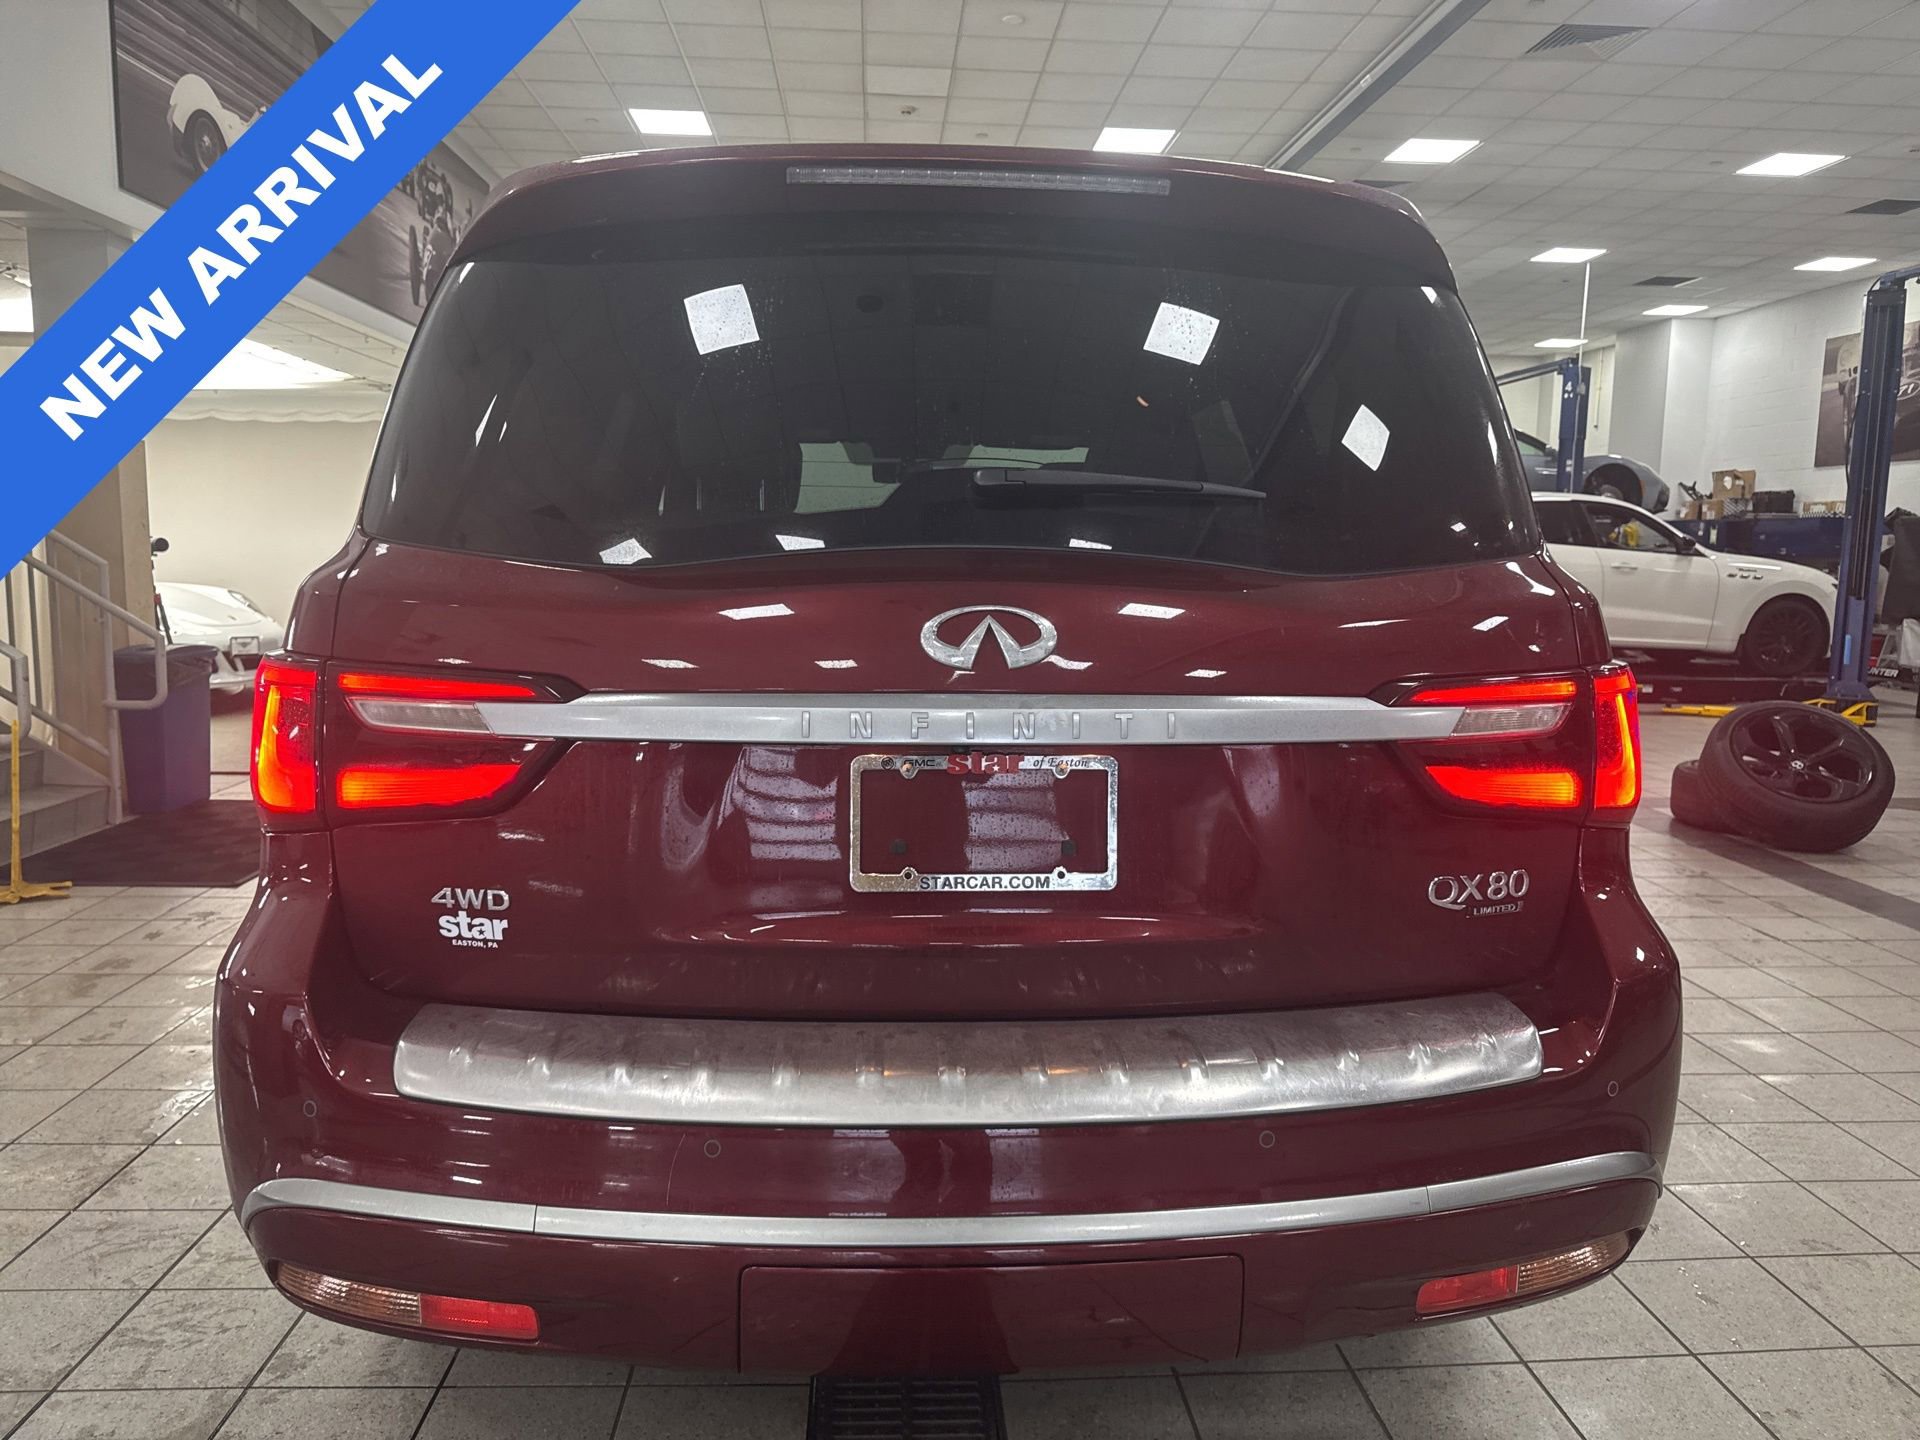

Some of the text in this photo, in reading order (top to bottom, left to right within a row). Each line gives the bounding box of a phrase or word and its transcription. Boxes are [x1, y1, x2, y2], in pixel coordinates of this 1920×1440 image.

[1565, 381, 1572, 391] 4
[802, 711, 1176, 739] INFINITI
[904, 751, 1087, 774] GMC star of Easton
[920, 876, 1050, 890] STARCAR.COM
[1428, 869, 1530, 910] QX80
[431, 887, 510, 911] 4WD
[1473, 903, 1516, 915] LIMITED
[438, 910, 508, 940] star
[452, 939, 499, 949] EASTON, PA
